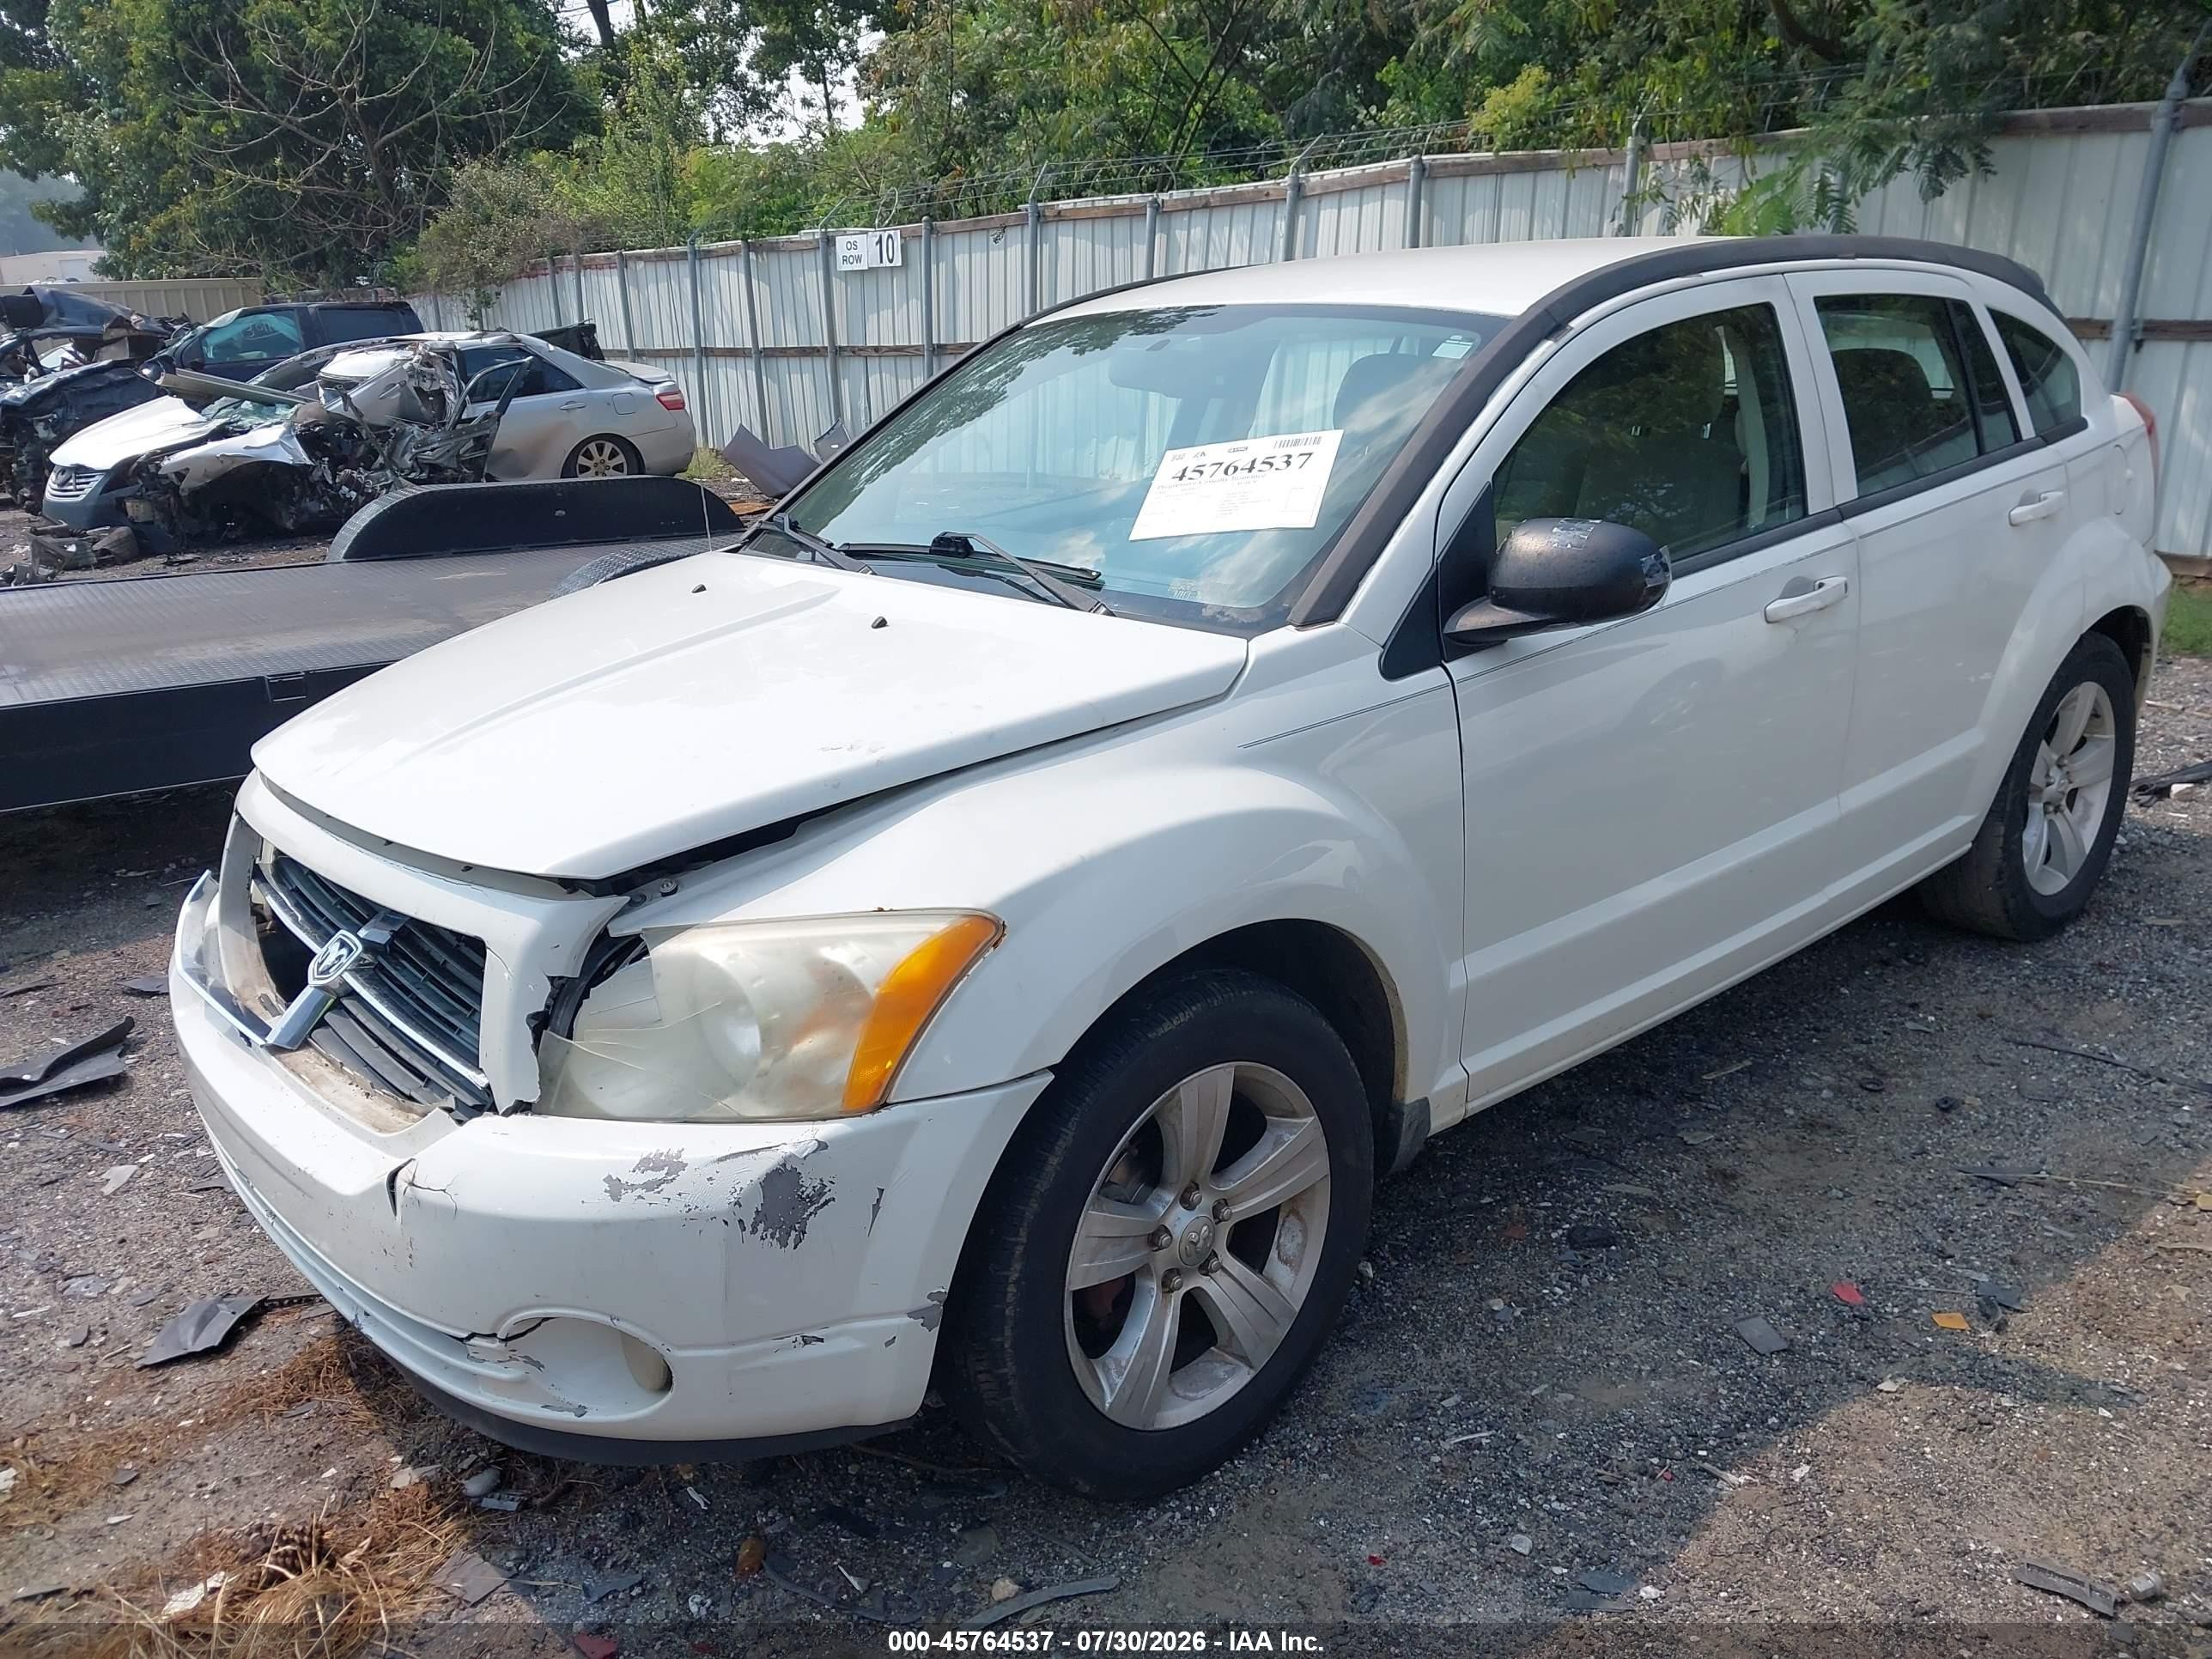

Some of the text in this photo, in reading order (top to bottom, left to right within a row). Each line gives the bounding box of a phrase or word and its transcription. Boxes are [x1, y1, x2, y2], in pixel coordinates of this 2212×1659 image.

[846, 240, 858, 251] OS
[876, 234, 895, 264] 10
[842, 254, 863, 265] ROW
[1171, 452, 1315, 482] 45764537
